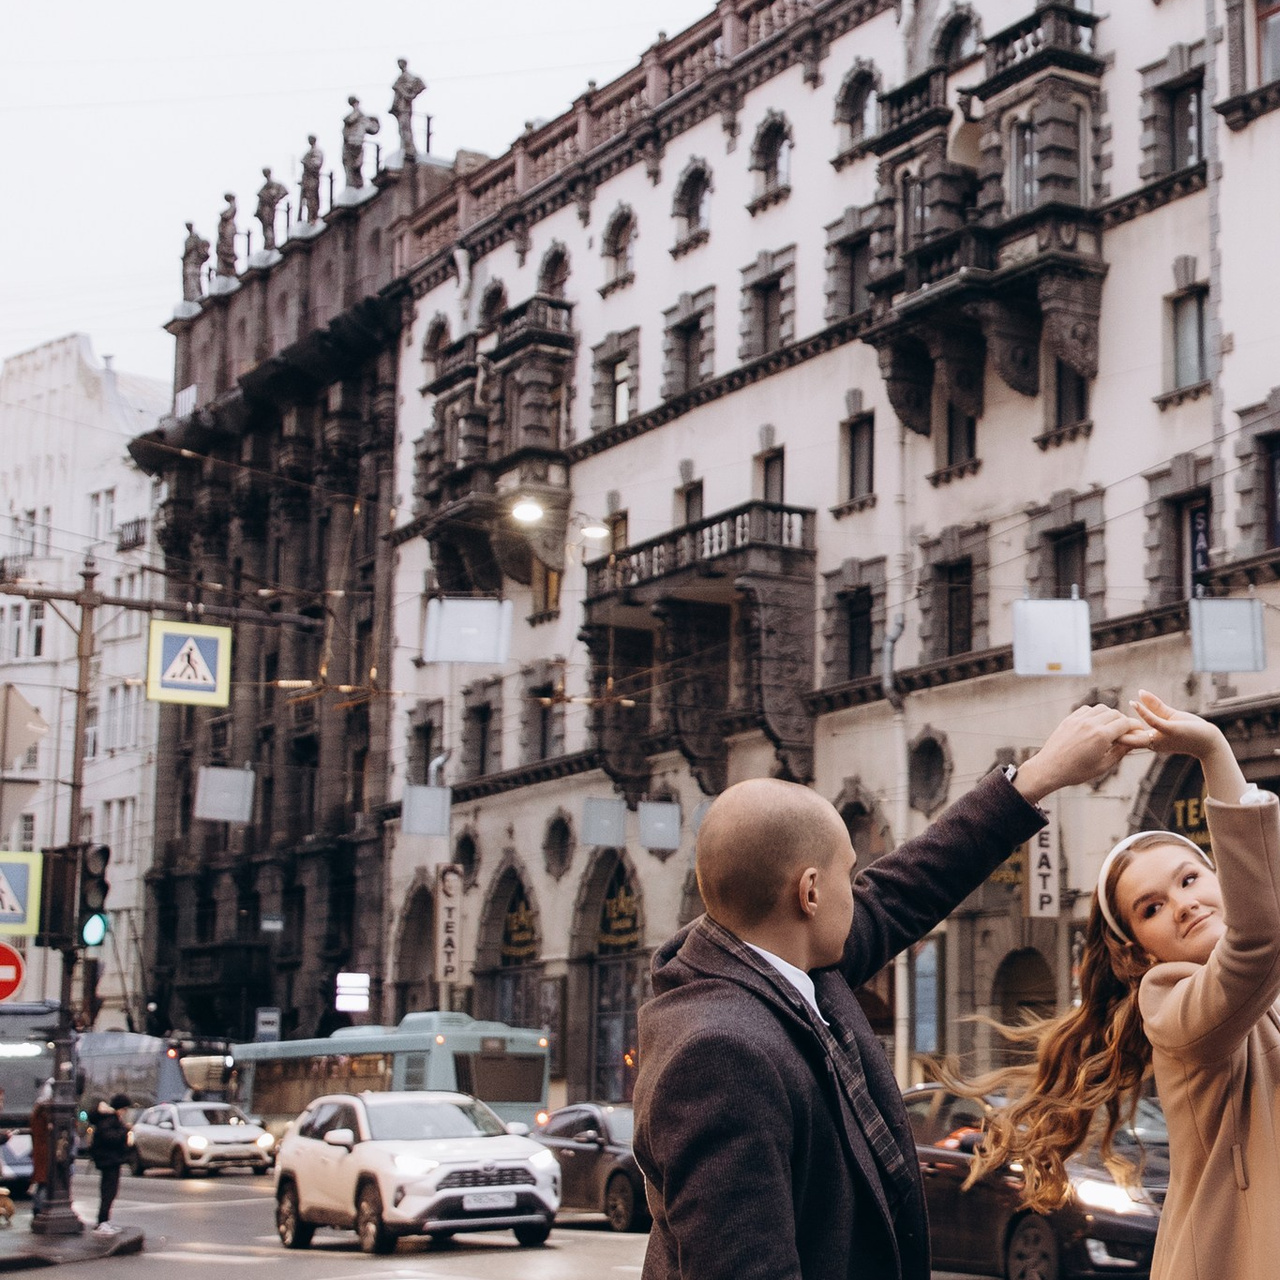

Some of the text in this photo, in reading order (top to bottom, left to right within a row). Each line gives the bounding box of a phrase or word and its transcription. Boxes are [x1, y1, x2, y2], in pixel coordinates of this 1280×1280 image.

[1195, 512, 1208, 572] SAL
[1038, 810, 1052, 910] ЕАТР
[444, 906, 456, 977] ТЕАТР
